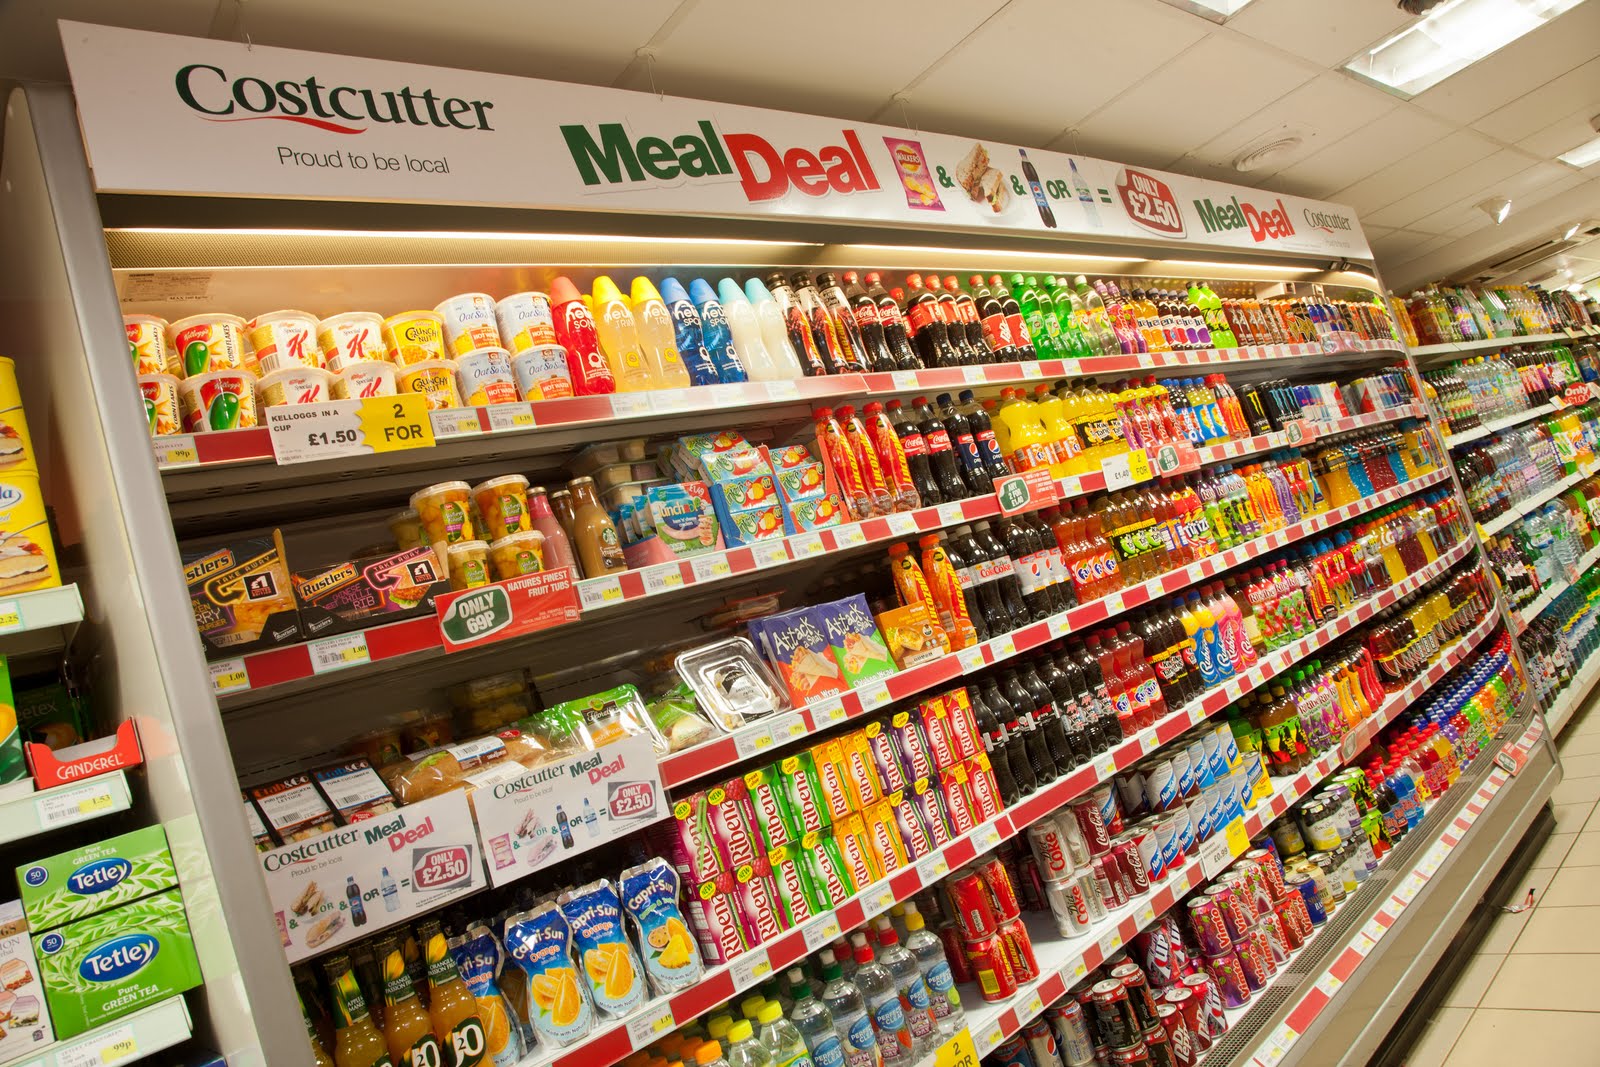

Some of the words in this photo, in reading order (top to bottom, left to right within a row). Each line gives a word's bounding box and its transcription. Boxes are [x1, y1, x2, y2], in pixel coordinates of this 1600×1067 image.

[175, 64, 495, 131] Costcutter
[277, 146, 342, 168] Proud
[348, 152, 368, 170] to
[375, 154, 400, 171] be
[405, 154, 450, 174] local
[559, 120, 733, 186] Meal
[723, 129, 880, 202] Deal
[1046, 179, 1071, 199] OR
[1132, 174, 1160, 199] ONLY
[1128, 190, 1179, 229] £2.50
[1193, 196, 1247, 233] Meal
[1240, 199, 1295, 242] Deal
[1303, 208, 1352, 231] Costcutter
[412, 376, 448, 392] CRUNCHY
[1565, 385, 1588, 400] Only
[271, 412, 317, 422] KELLOGGS
[394, 404, 405, 418] 2
[273, 424, 291, 432] CUP
[308, 429, 357, 446] £1.50
[384, 424, 424, 442] FOR
[1136, 455, 1141, 463] 2
[1136, 466, 1148, 476] FOR
[187, 556, 229, 581] stlers
[216, 571, 240, 585] TAKE
[245, 556, 270, 572] AWAY
[374, 560, 396, 572] TAKE
[398, 549, 420, 562] AWAY
[414, 563, 429, 575] £1
[251, 575, 269, 589] £1
[303, 568, 353, 597] Rustlers
[332, 583, 360, 600] CHINESE
[507, 576, 540, 592] NATURES
[542, 571, 568, 584] FINEST
[528, 586, 549, 598] FRUIT
[550, 580, 570, 590] TUBS
[353, 595, 375, 610] RIB
[459, 592, 494, 619] ONLY
[467, 612, 496, 634] 69P
[826, 603, 865, 640] Attack
[772, 616, 815, 656] Attack
[352, 645, 367, 653] 1.00
[229, 672, 246, 681] 1.00
[929, 716, 951, 766] Ribena
[953, 706, 974, 755] Ribena
[57, 754, 124, 780] CANDEREL
[875, 732, 904, 791] Ribena
[494, 763, 565, 799] Costcutter
[569, 752, 603, 778] Meal
[587, 754, 625, 785] Deal
[93, 795, 110, 805] 1.53
[622, 785, 641, 797] ONLY
[708, 790, 724, 801] NEW
[823, 762, 848, 816] Ribena
[973, 769, 996, 821] Ribena
[616, 791, 651, 814] £2.50
[675, 804, 690, 817] NEW
[949, 781, 973, 834] Ribena
[536, 825, 548, 836] OR
[570, 815, 583, 828] OR
[757, 783, 788, 848] Ribena
[721, 799, 752, 866] Ribena
[899, 800, 930, 860] Ribena
[85, 846, 101, 856] Pure
[264, 829, 358, 872] Costcutter
[364, 815, 407, 845] Meal
[388, 816, 434, 853] Deal
[1045, 831, 1067, 872] Coke
[73, 853, 99, 865] GREEN
[101, 846, 117, 857] TEA
[291, 865, 311, 878] Proud
[311, 863, 318, 872] to
[317, 860, 326, 870] be
[326, 856, 343, 867] local
[430, 851, 454, 867] ONLY
[845, 834, 870, 890] Ribena
[31, 870, 41, 880] 50
[72, 862, 127, 890] Tetley
[422, 858, 465, 885] £2.50
[738, 869, 751, 879] NEW
[320, 902, 334, 913] OR
[363, 888, 380, 902] OR
[628, 879, 673, 911] Capri-Sun
[701, 884, 714, 895] NEW
[781, 859, 812, 925] Ribena
[1073, 885, 1089, 925] Coke
[582, 920, 613, 939] Orange
[711, 892, 744, 962] Ribena
[47, 938, 57, 948] 50
[530, 944, 561, 963] Orange
[86, 939, 154, 976] Tetley
[102, 991, 138, 1012] GREEN
[140, 984, 159, 999] TEA
[118, 983, 139, 997] Pure
[113, 1040, 132, 1051] 99p
[953, 1042, 962, 1055] 2
